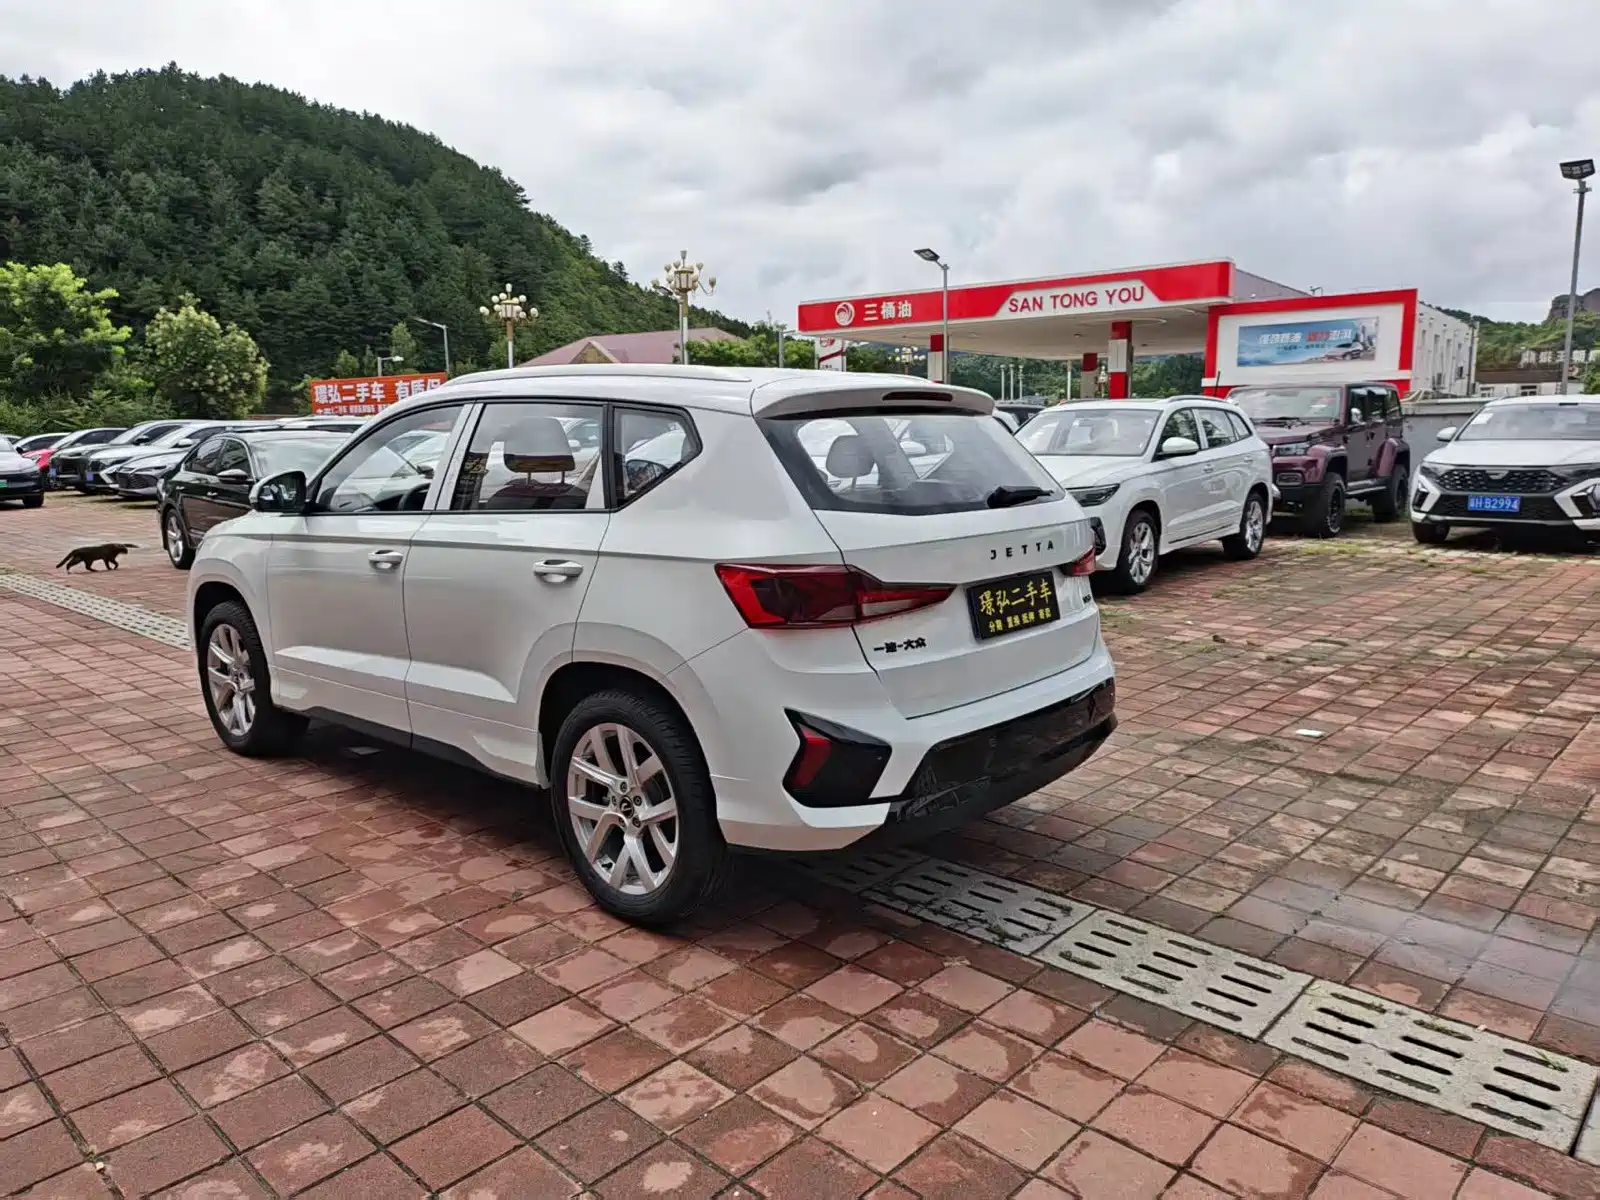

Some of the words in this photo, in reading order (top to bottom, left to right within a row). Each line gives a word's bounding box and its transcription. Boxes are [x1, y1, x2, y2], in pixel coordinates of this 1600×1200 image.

[1008, 296, 1043, 313] SAN
[1050, 291, 1097, 309] TONG
[1105, 285, 1145, 304] YOU
[863, 300, 912, 321] 三桶油
[990, 540, 1054, 560] JETTA
